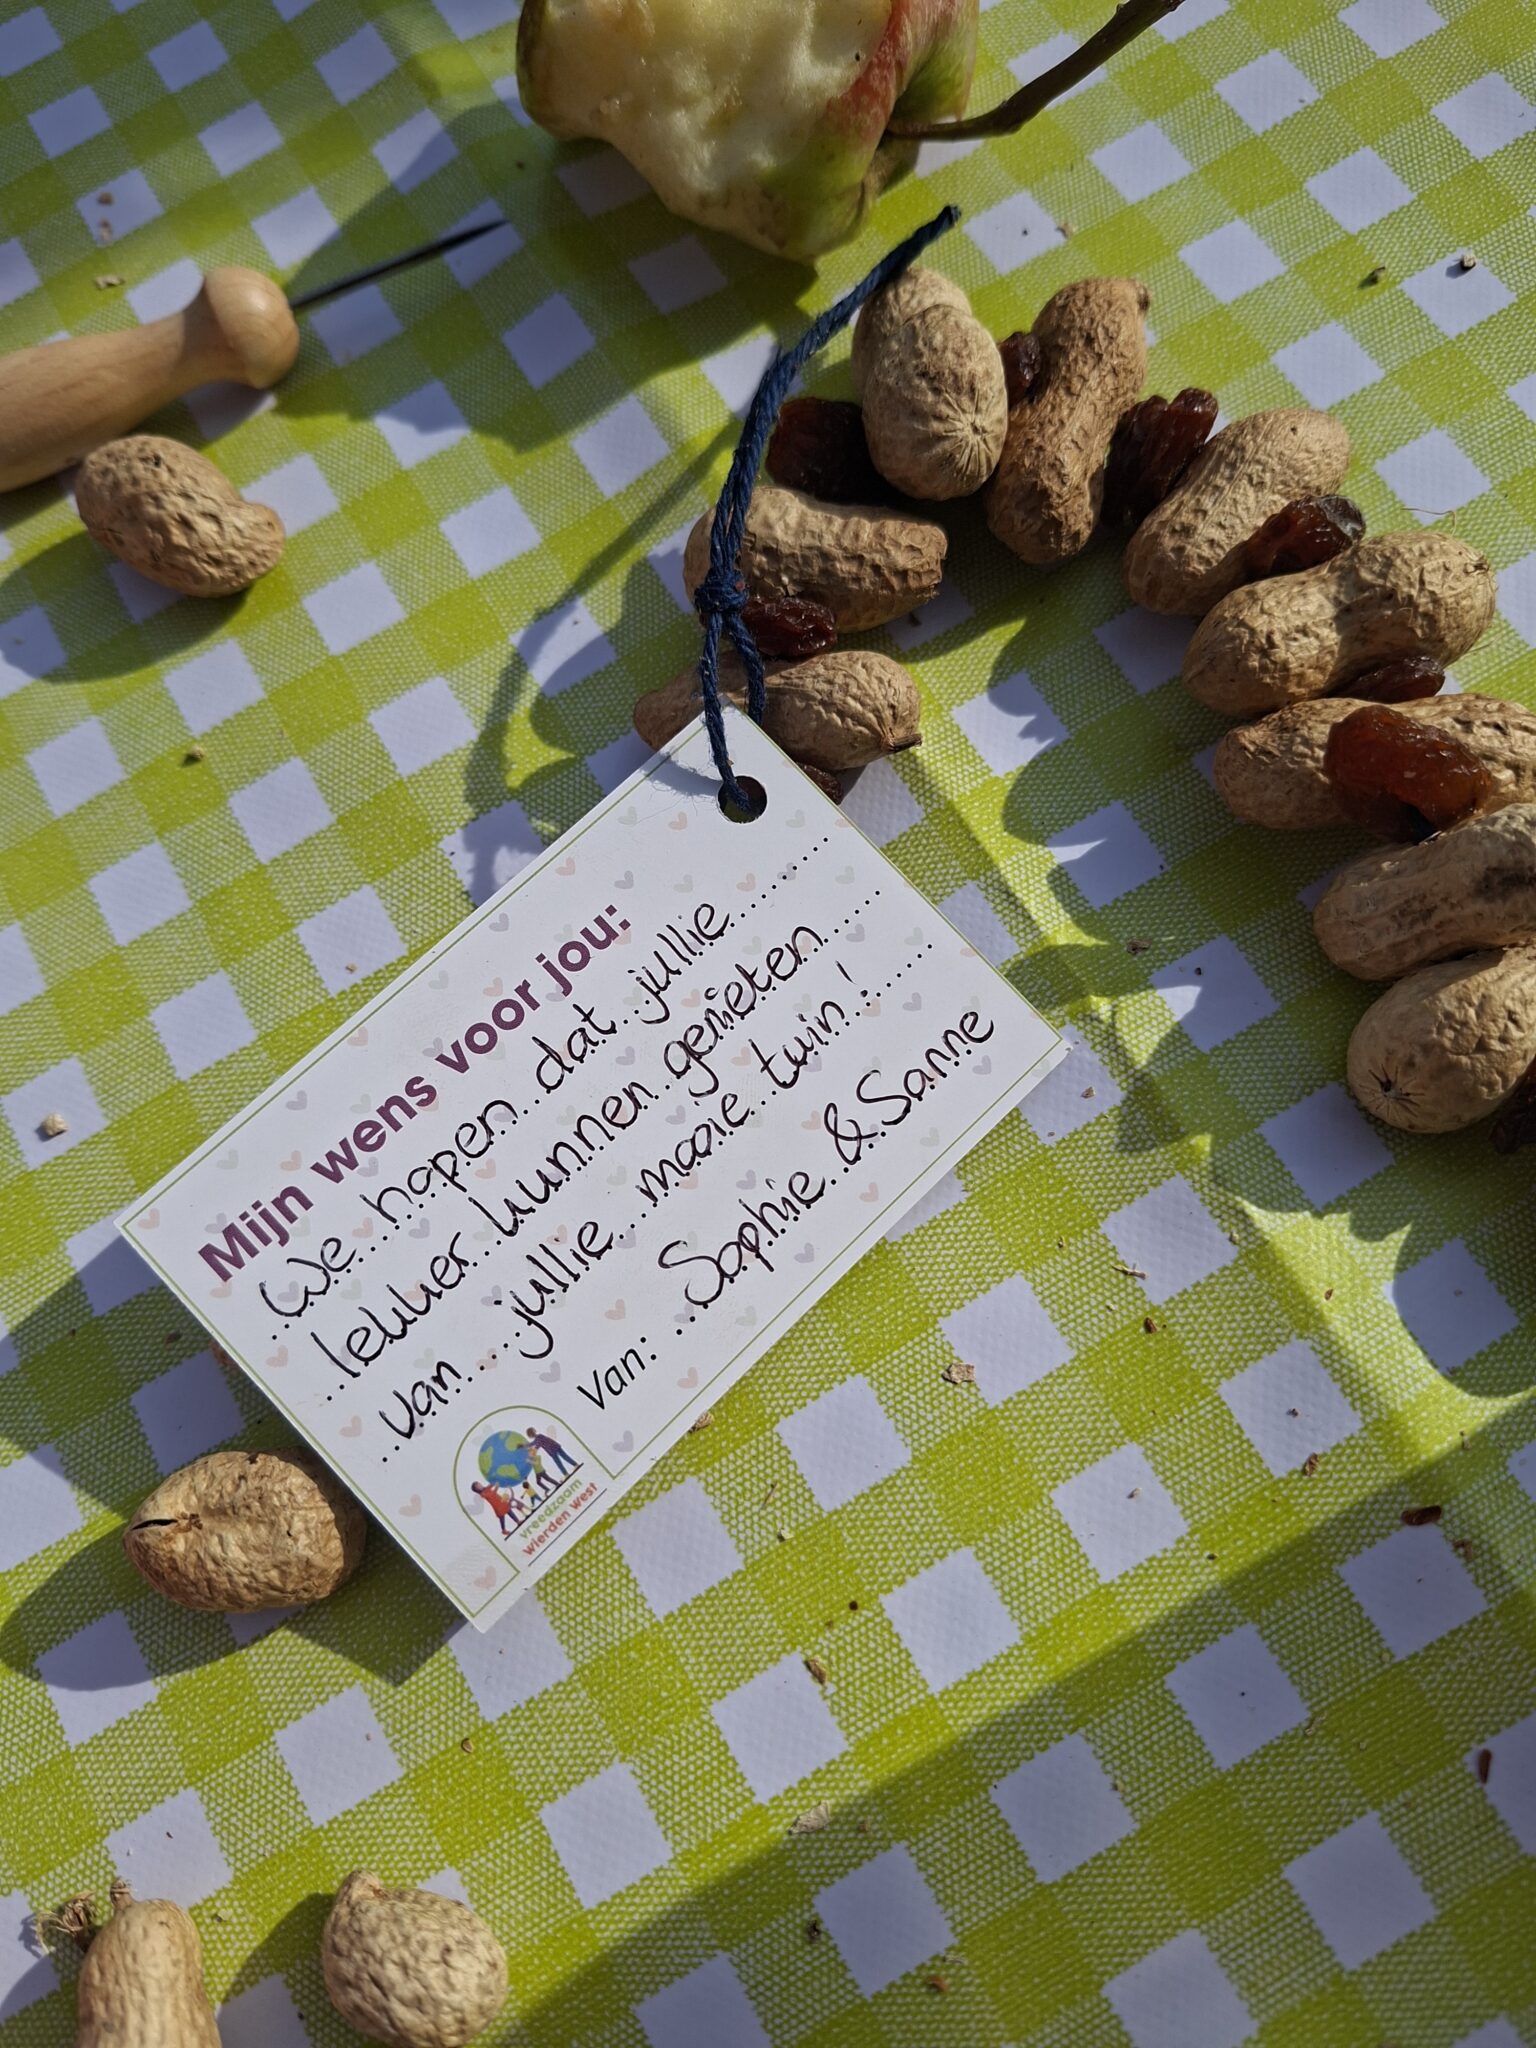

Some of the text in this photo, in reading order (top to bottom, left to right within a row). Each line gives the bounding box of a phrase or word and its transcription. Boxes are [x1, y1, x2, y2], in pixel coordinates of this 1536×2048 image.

[198, 904, 631, 1282] Mijn wens voor jou:
[259, 902, 730, 1317] We hopen dat jullie
[664, 925, 824, 1098] genieten
[494, 1221, 614, 1358] jullie
[635, 1092, 750, 1203] mooie
[576, 1010, 995, 1410] Van: Sophie & Sanne
[520, 1478, 582, 1539] vreedzaam
[522, 1481, 598, 1556] wierden west
